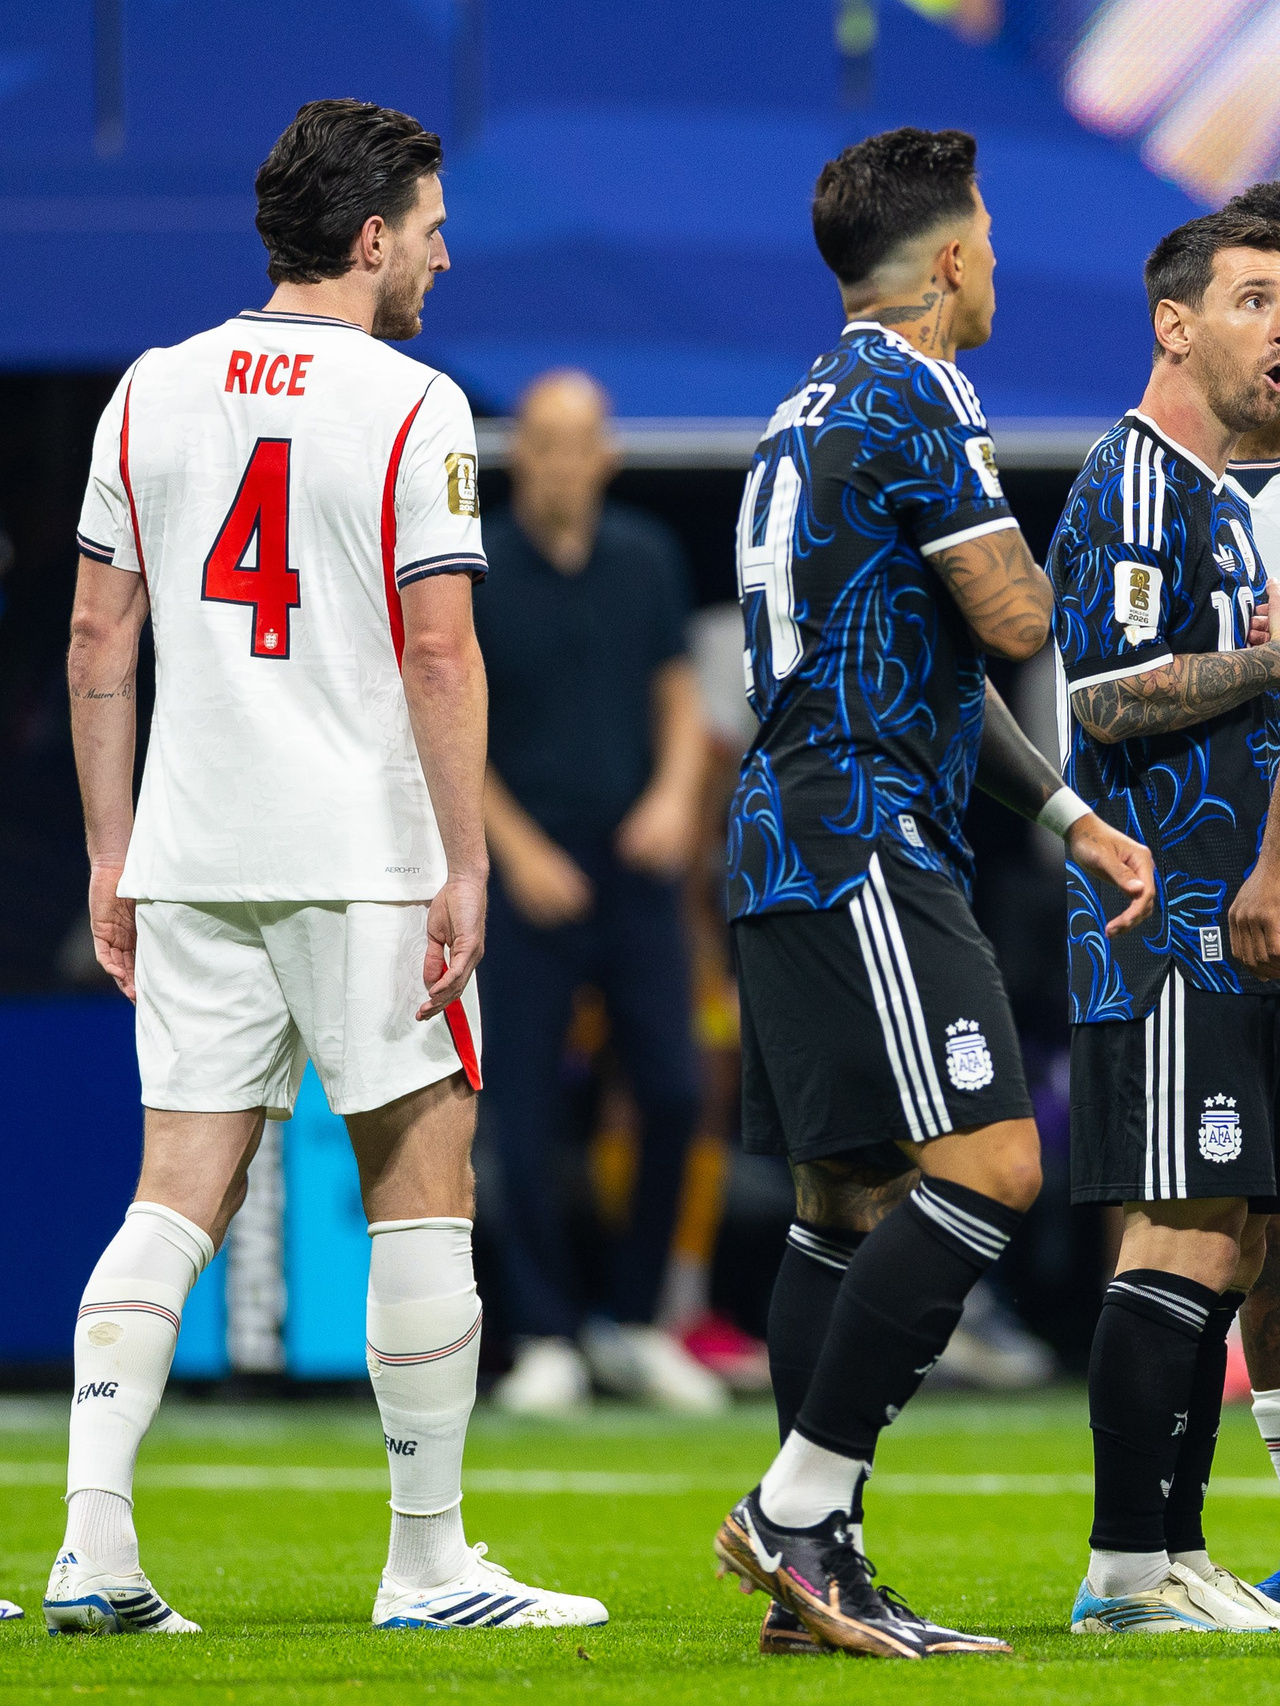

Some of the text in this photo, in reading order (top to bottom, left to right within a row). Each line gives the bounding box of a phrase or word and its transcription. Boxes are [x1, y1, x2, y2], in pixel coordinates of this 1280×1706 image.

[225, 349, 315, 397] RICE
[201, 437, 301, 660] 4
[77, 1381, 119, 1405] ENG
[384, 1432, 418, 1456] ENG
